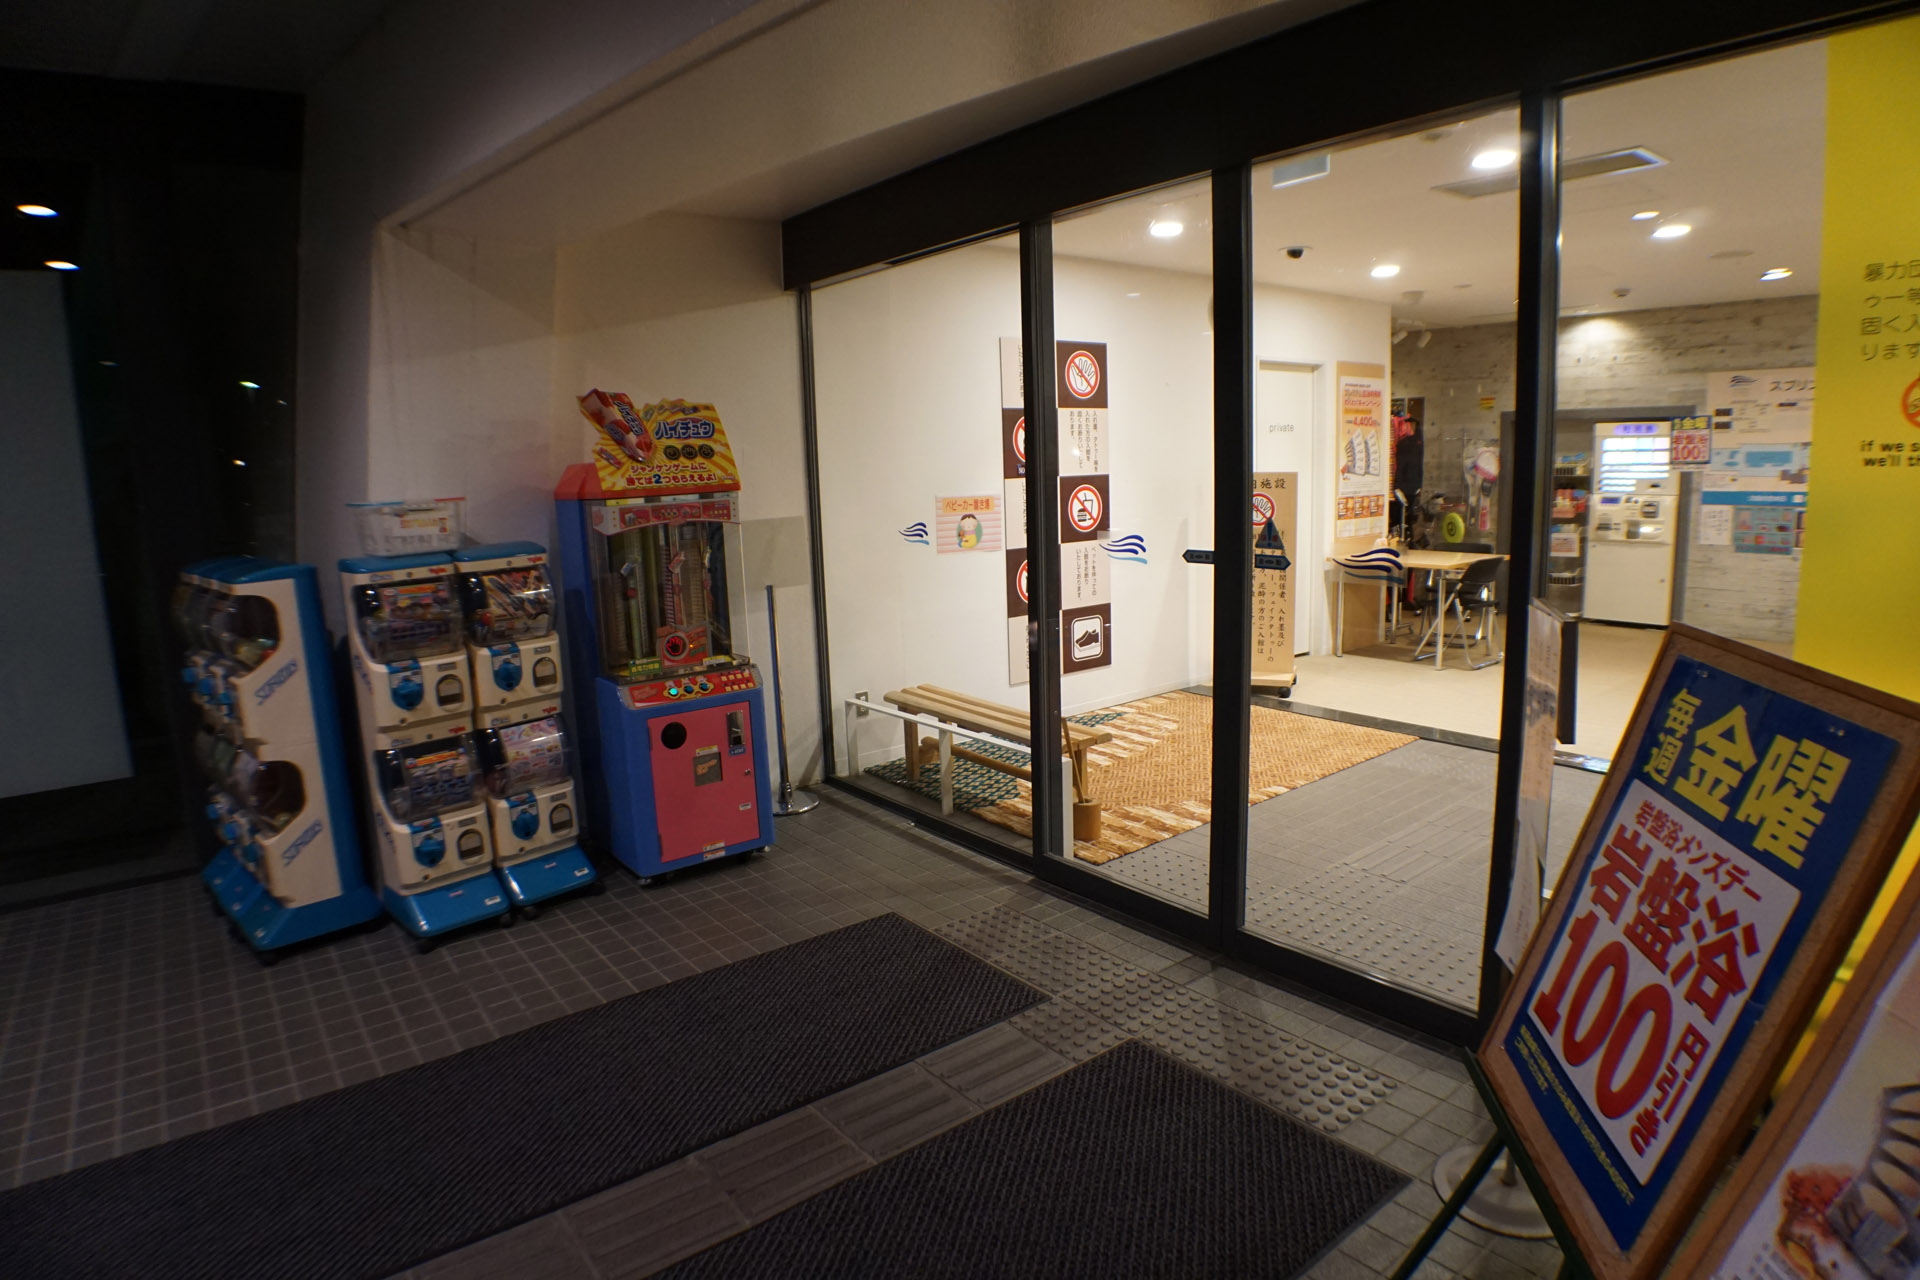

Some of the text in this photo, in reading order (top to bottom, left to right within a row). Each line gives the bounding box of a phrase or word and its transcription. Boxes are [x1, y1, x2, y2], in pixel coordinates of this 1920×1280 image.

[654, 419, 715, 440] ハイチュウ
[1269, 423, 1295, 433] private
[1880, 443, 1904, 452] we
[1643, 687, 1702, 786] 毎週
[1673, 704, 1851, 870] 金曜
[1634, 799, 1763, 903] 岩盤浴メンズデー
[1590, 823, 1761, 1026] 岩盤浴
[1532, 910, 1674, 1121] 100
[1629, 1021, 1711, 1158] 円引き
